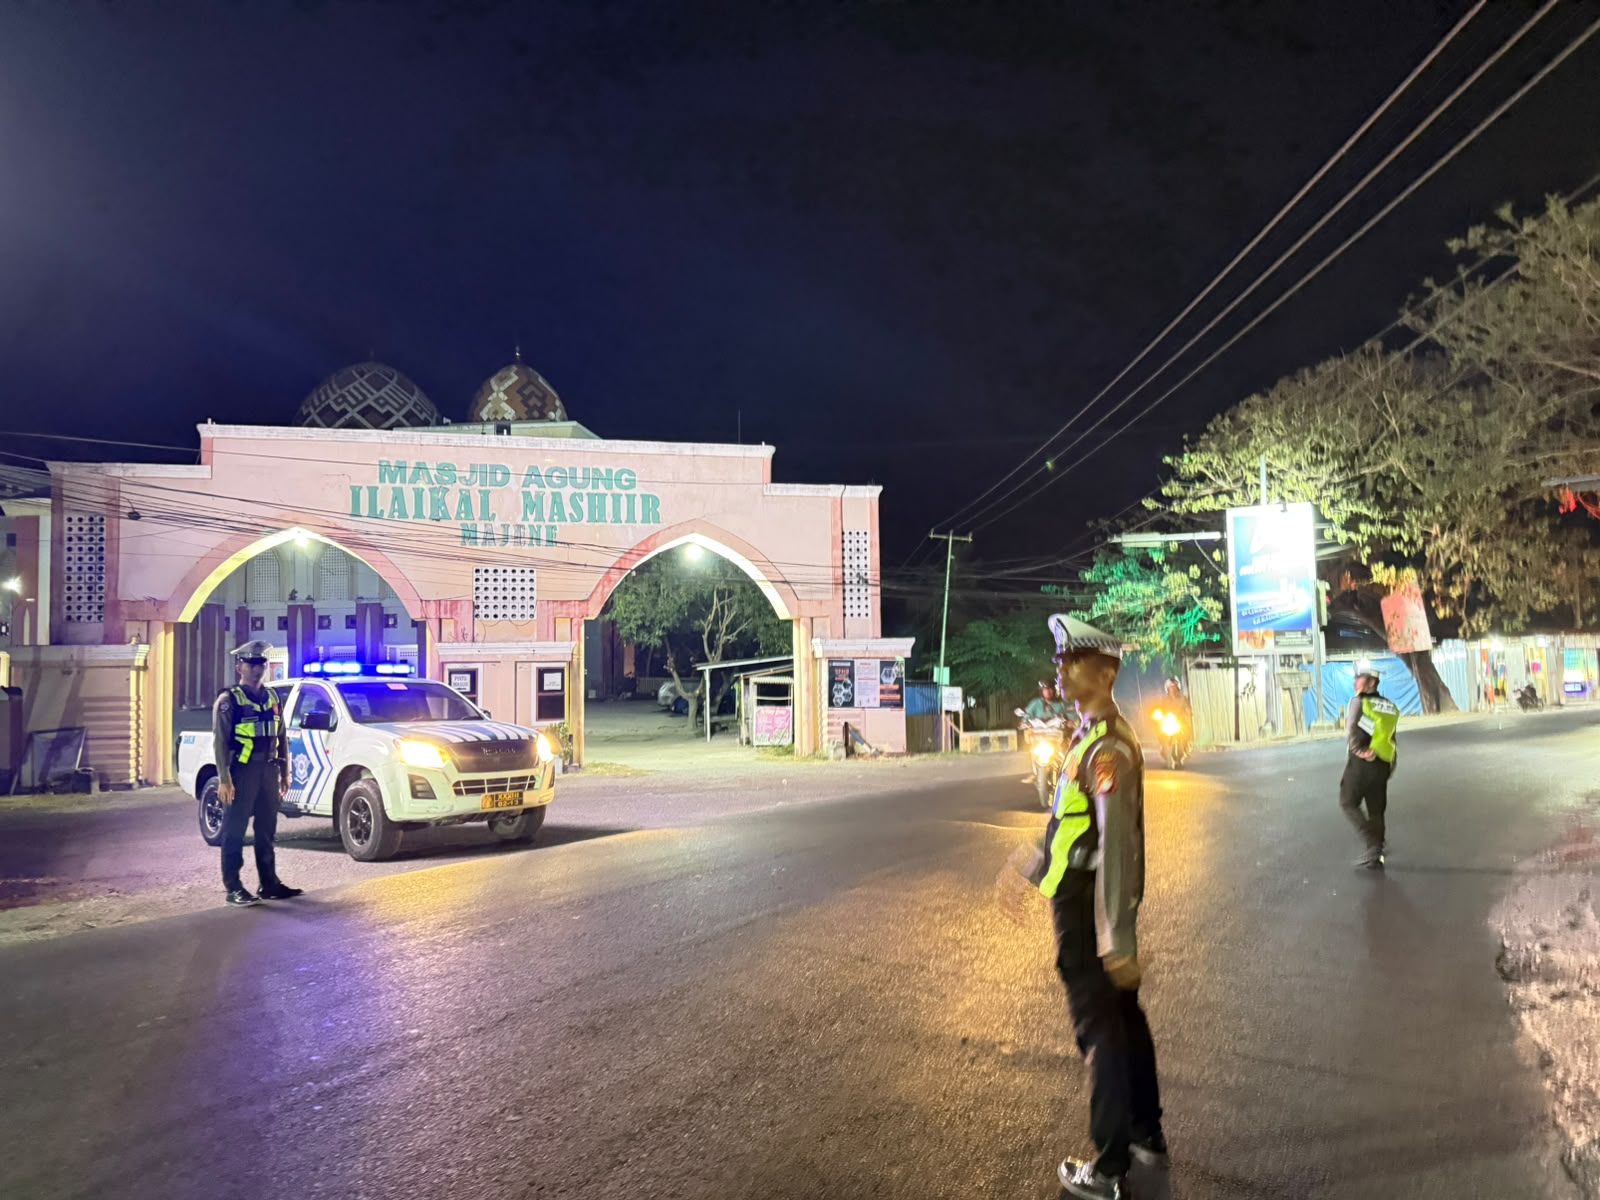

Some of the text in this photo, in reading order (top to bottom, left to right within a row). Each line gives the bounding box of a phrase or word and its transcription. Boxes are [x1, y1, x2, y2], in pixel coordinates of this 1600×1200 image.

[379, 460, 637, 491] MASJID AGUNG
[350, 485, 661, 524] ILAIKAL MASHIIR
[460, 523, 558, 547] MAJENE
